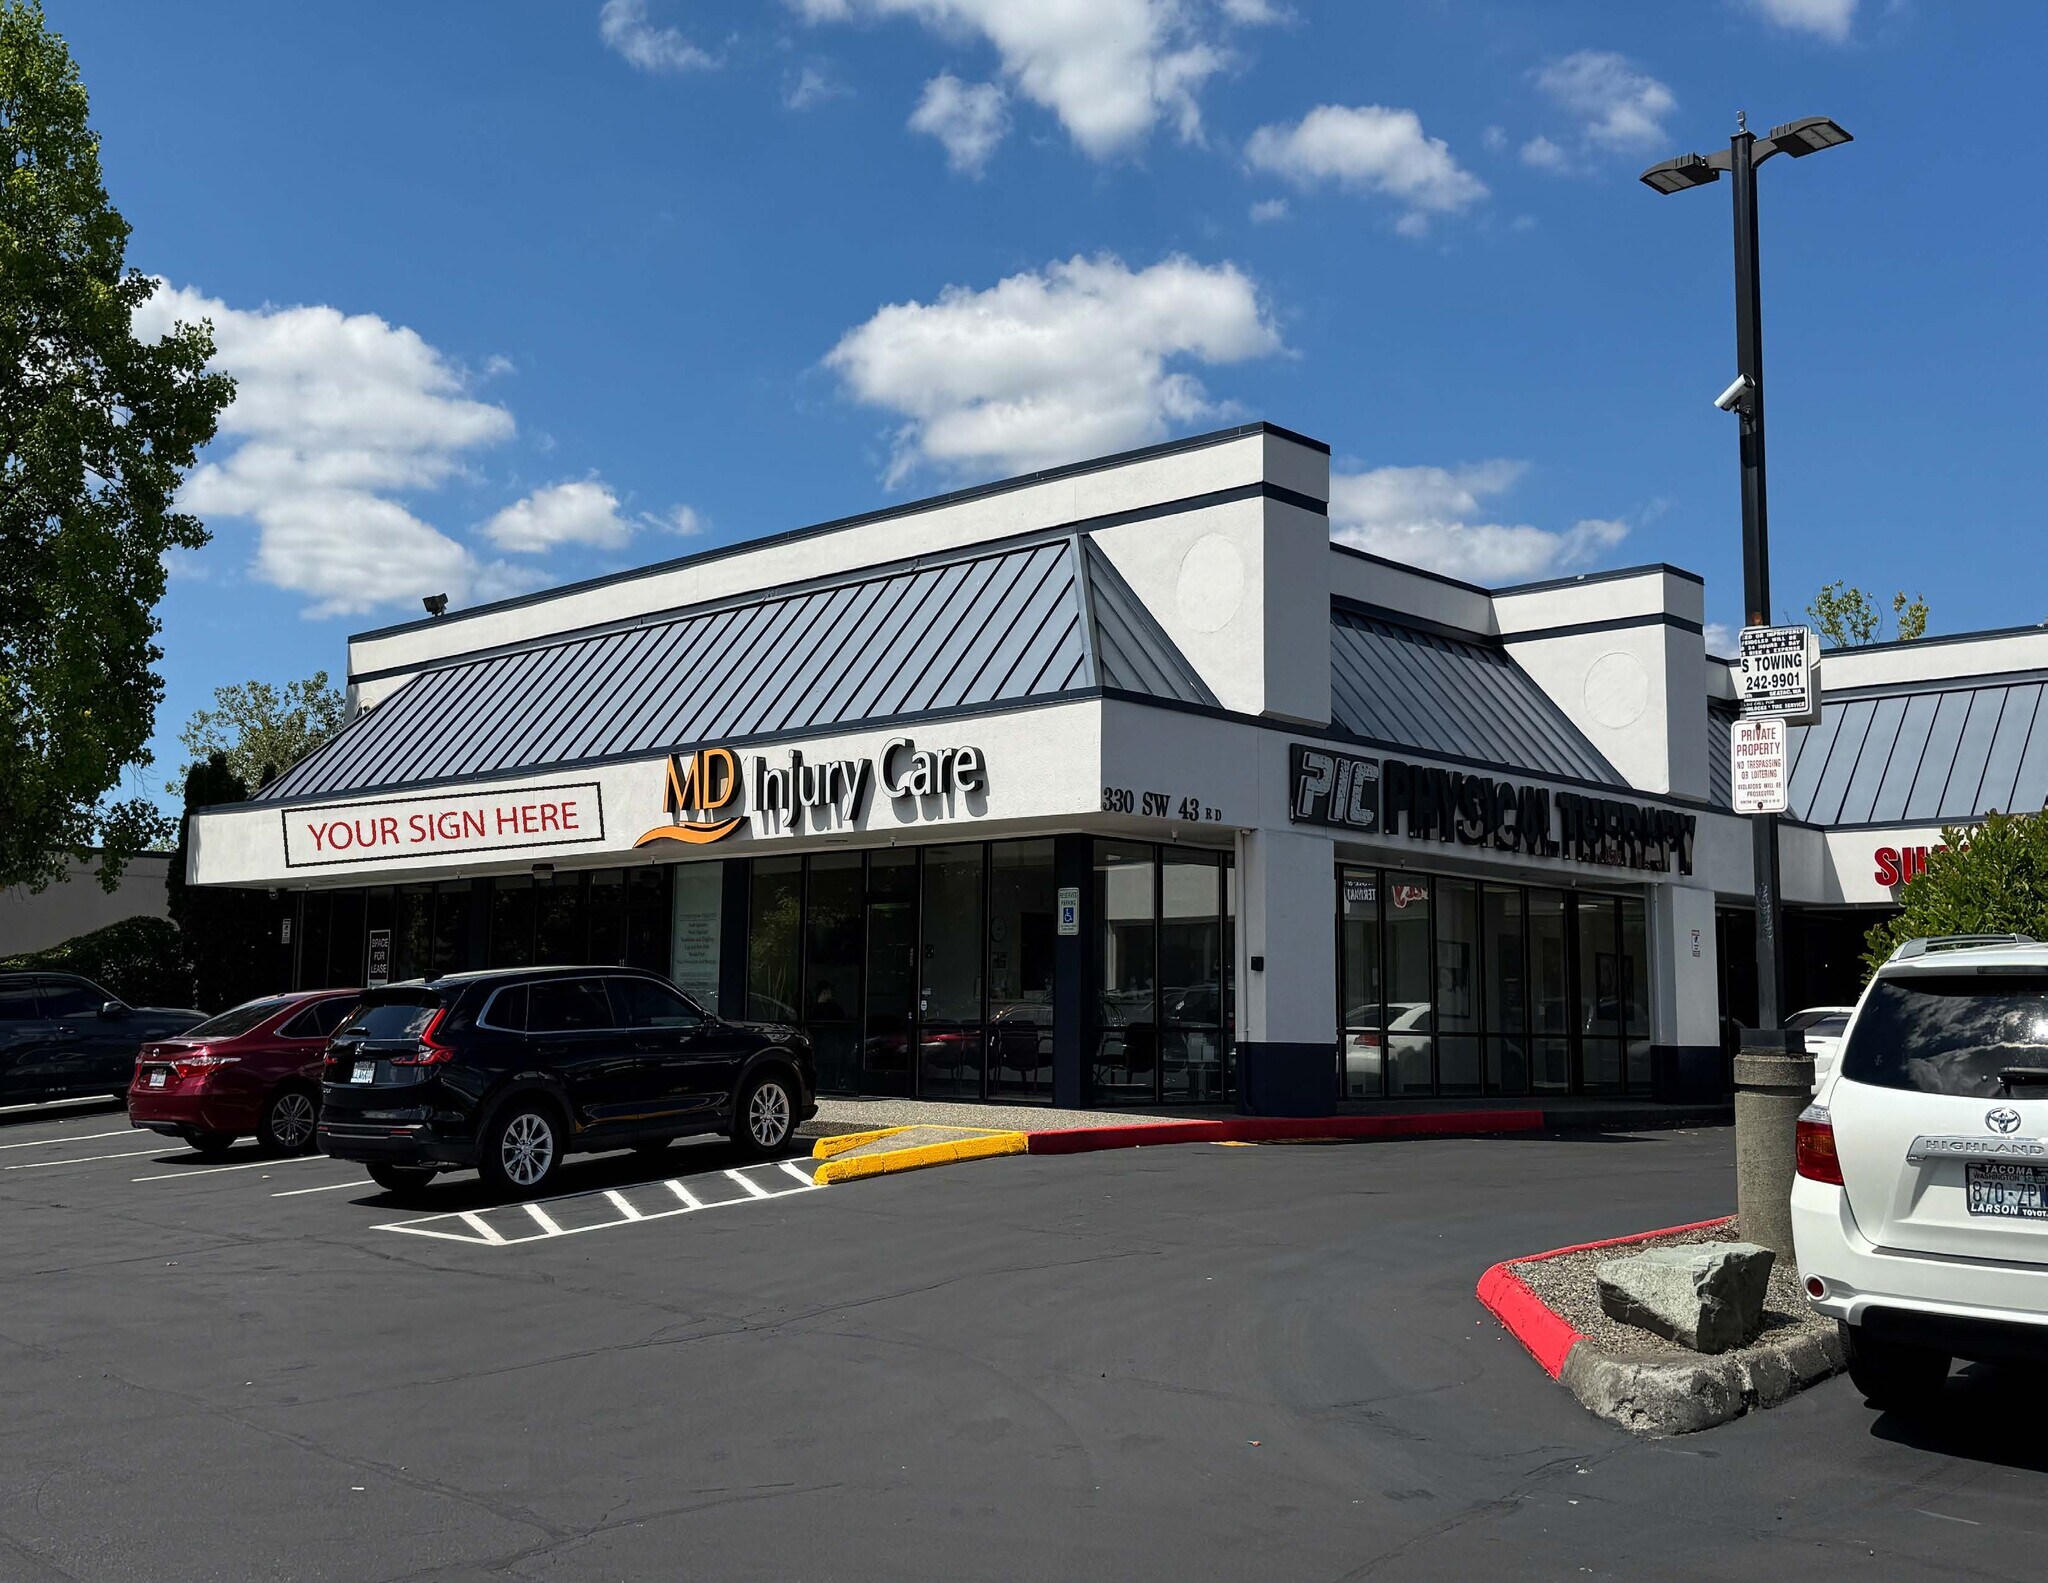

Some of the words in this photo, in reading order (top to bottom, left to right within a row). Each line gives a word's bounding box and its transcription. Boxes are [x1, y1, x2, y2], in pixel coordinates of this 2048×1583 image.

[1742, 658, 1749, 673] S
[1755, 653, 1802, 672] TOWING
[1741, 728, 1776, 741] PRIVATE
[1736, 742, 1780, 756] PROPERTY
[1736, 760, 1745, 770] NO
[1747, 758, 1781, 769] TRESPASSING
[1751, 768, 1777, 780] LOITERING
[663, 748, 743, 813] MD
[752, 750, 872, 828] Injury
[878, 737, 986, 799] Care
[1103, 786, 1135, 814] 330
[1142, 791, 1171, 817] SW
[1178, 796, 1200, 821] 43
[1204, 807, 1222, 821] RD
[1296, 751, 1380, 827] PIC
[1384, 759, 1560, 858] PHYSICAL
[1556, 792, 1697, 876] THERAPY
[307, 816, 400, 851] YOUR
[409, 809, 486, 844] SIGN
[496, 801, 580, 834] HERE
[371, 938, 389, 948] SPACE
[373, 951, 386, 961] FOR
[370, 963, 387, 974] LEASE
[1972, 1171, 2020, 1182] WASHINGTON
[1984, 1164, 2034, 1176] TACOMA
[1970, 1202, 2019, 1216] LARSON
